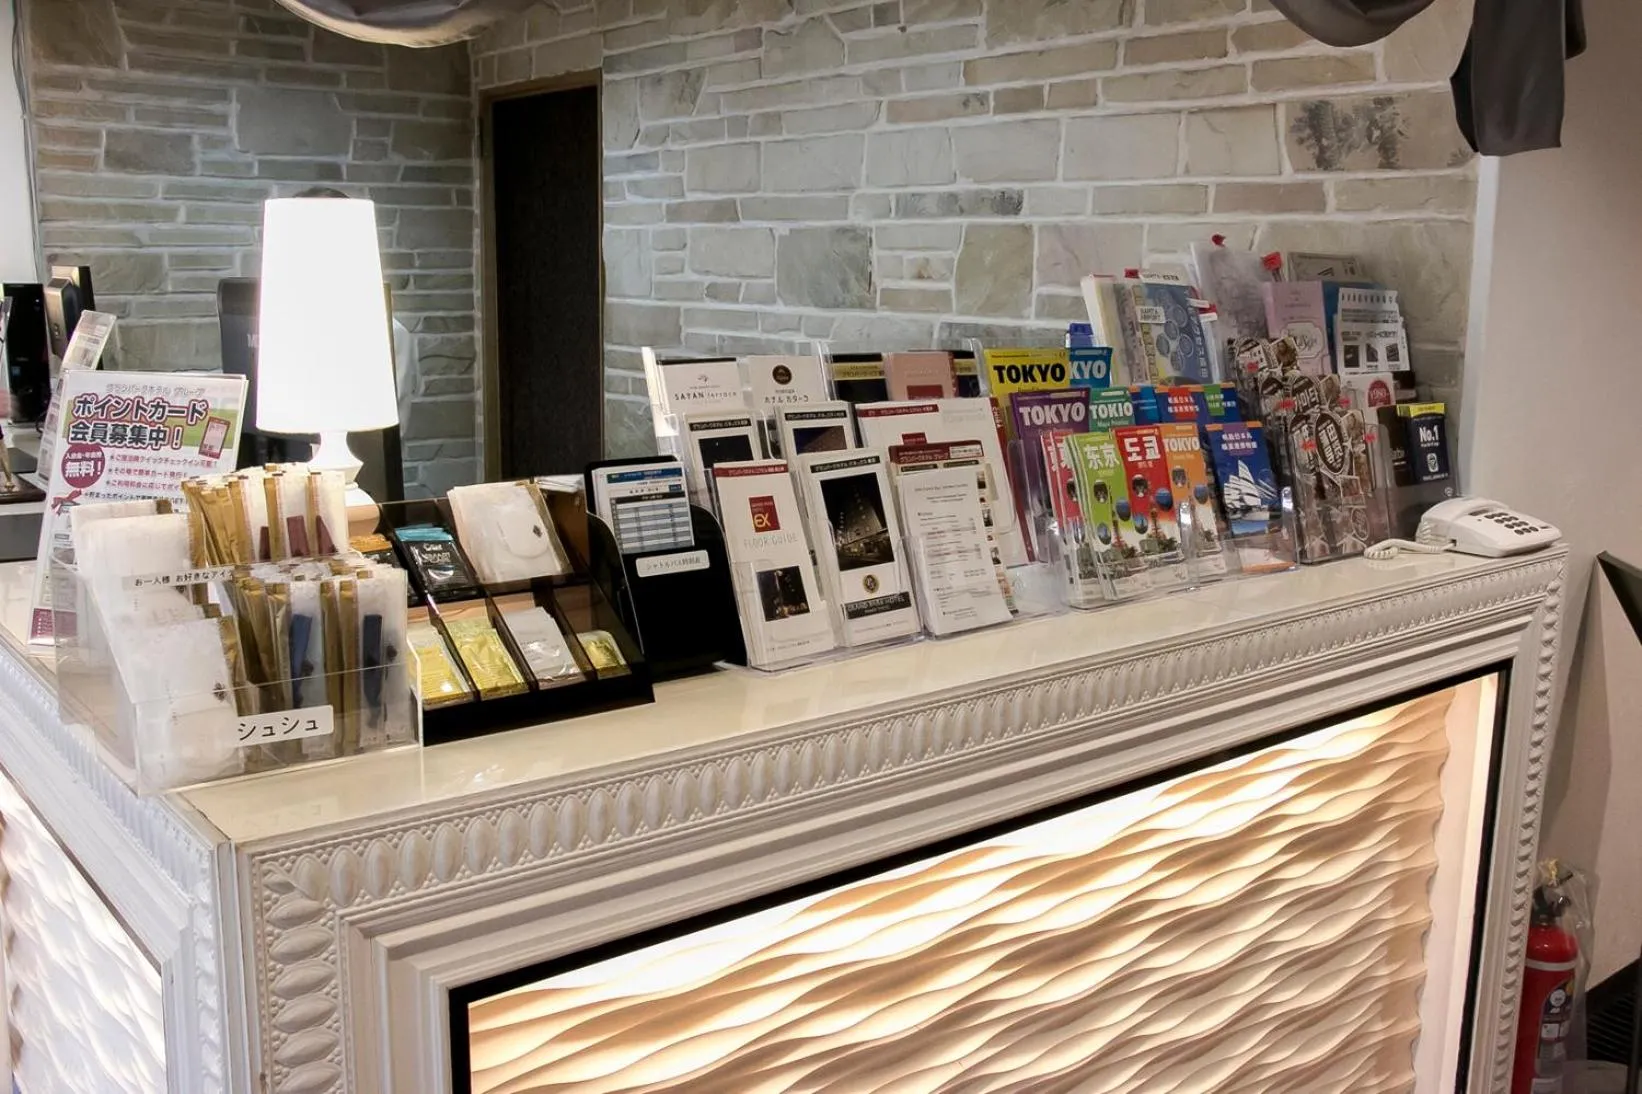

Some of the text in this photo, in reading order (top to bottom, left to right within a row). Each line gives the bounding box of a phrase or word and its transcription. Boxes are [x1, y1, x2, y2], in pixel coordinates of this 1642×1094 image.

[993, 363, 1066, 385] TOKYO
[1069, 360, 1107, 380] KYO
[74, 396, 208, 424] ポイントカード
[1019, 401, 1086, 426] TOKYO
[1089, 402, 1134, 419] TOKIO
[69, 420, 184, 449] 会員募集中！
[1164, 436, 1200, 452] TOKYO
[1419, 425, 1440, 443] No.1
[1123, 434, 1162, 462] 도쿄
[64, 460, 102, 478] 無料！
[237, 716, 319, 741] シュシュ
